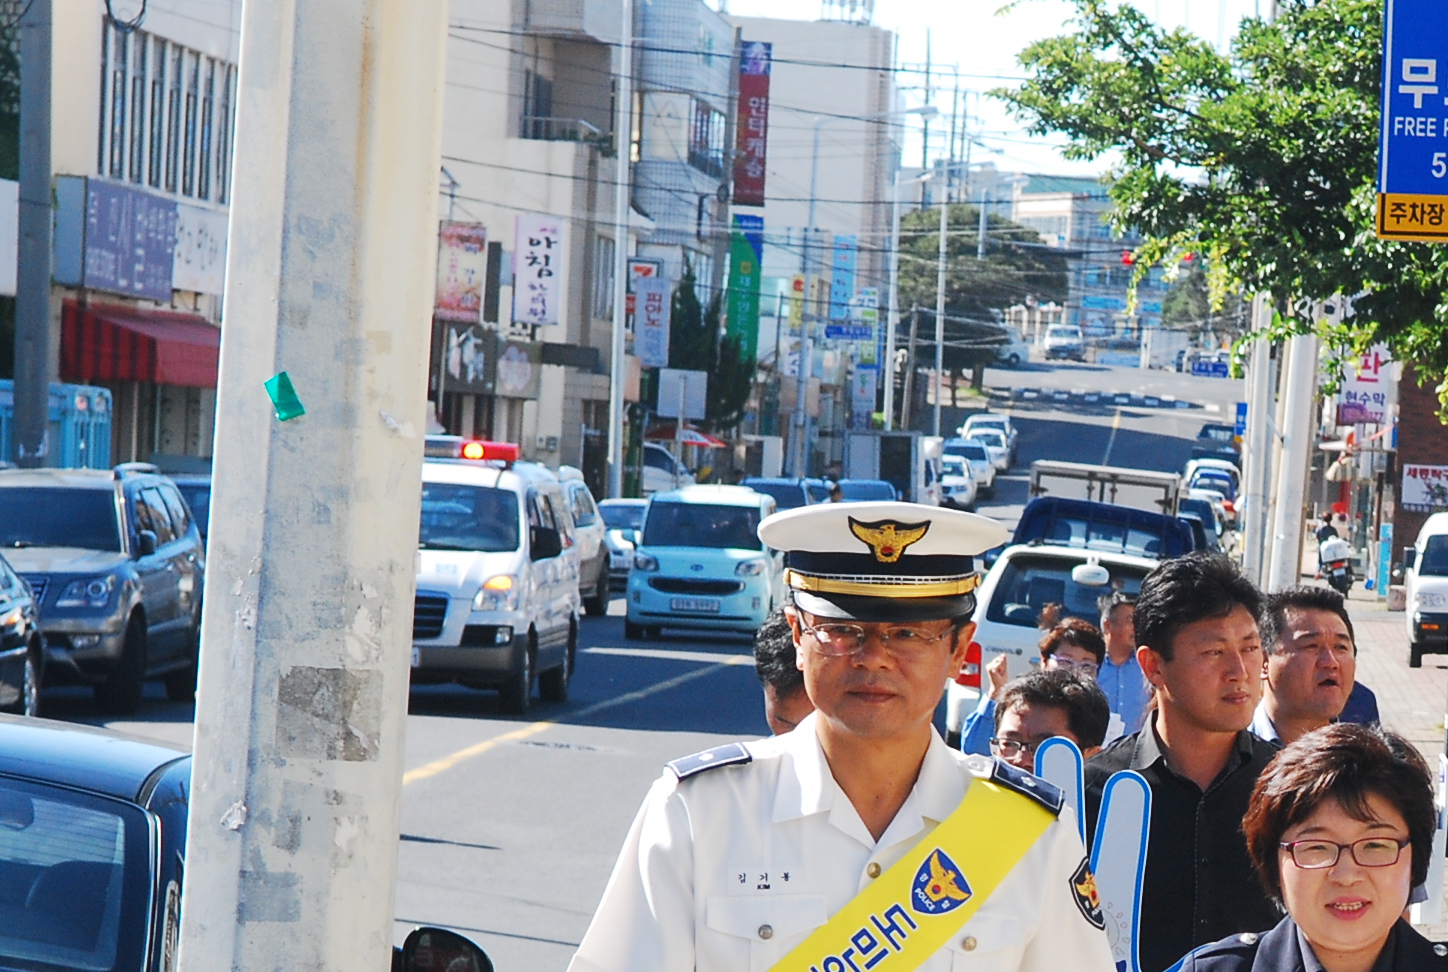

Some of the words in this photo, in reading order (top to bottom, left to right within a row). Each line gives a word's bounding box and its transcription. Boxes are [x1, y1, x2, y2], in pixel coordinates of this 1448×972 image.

[1394, 117, 1437, 137] FREE
[1390, 202, 1444, 226] 주차장
[1345, 390, 1386, 407] 현수막
[914, 887, 936, 911] POLICE
